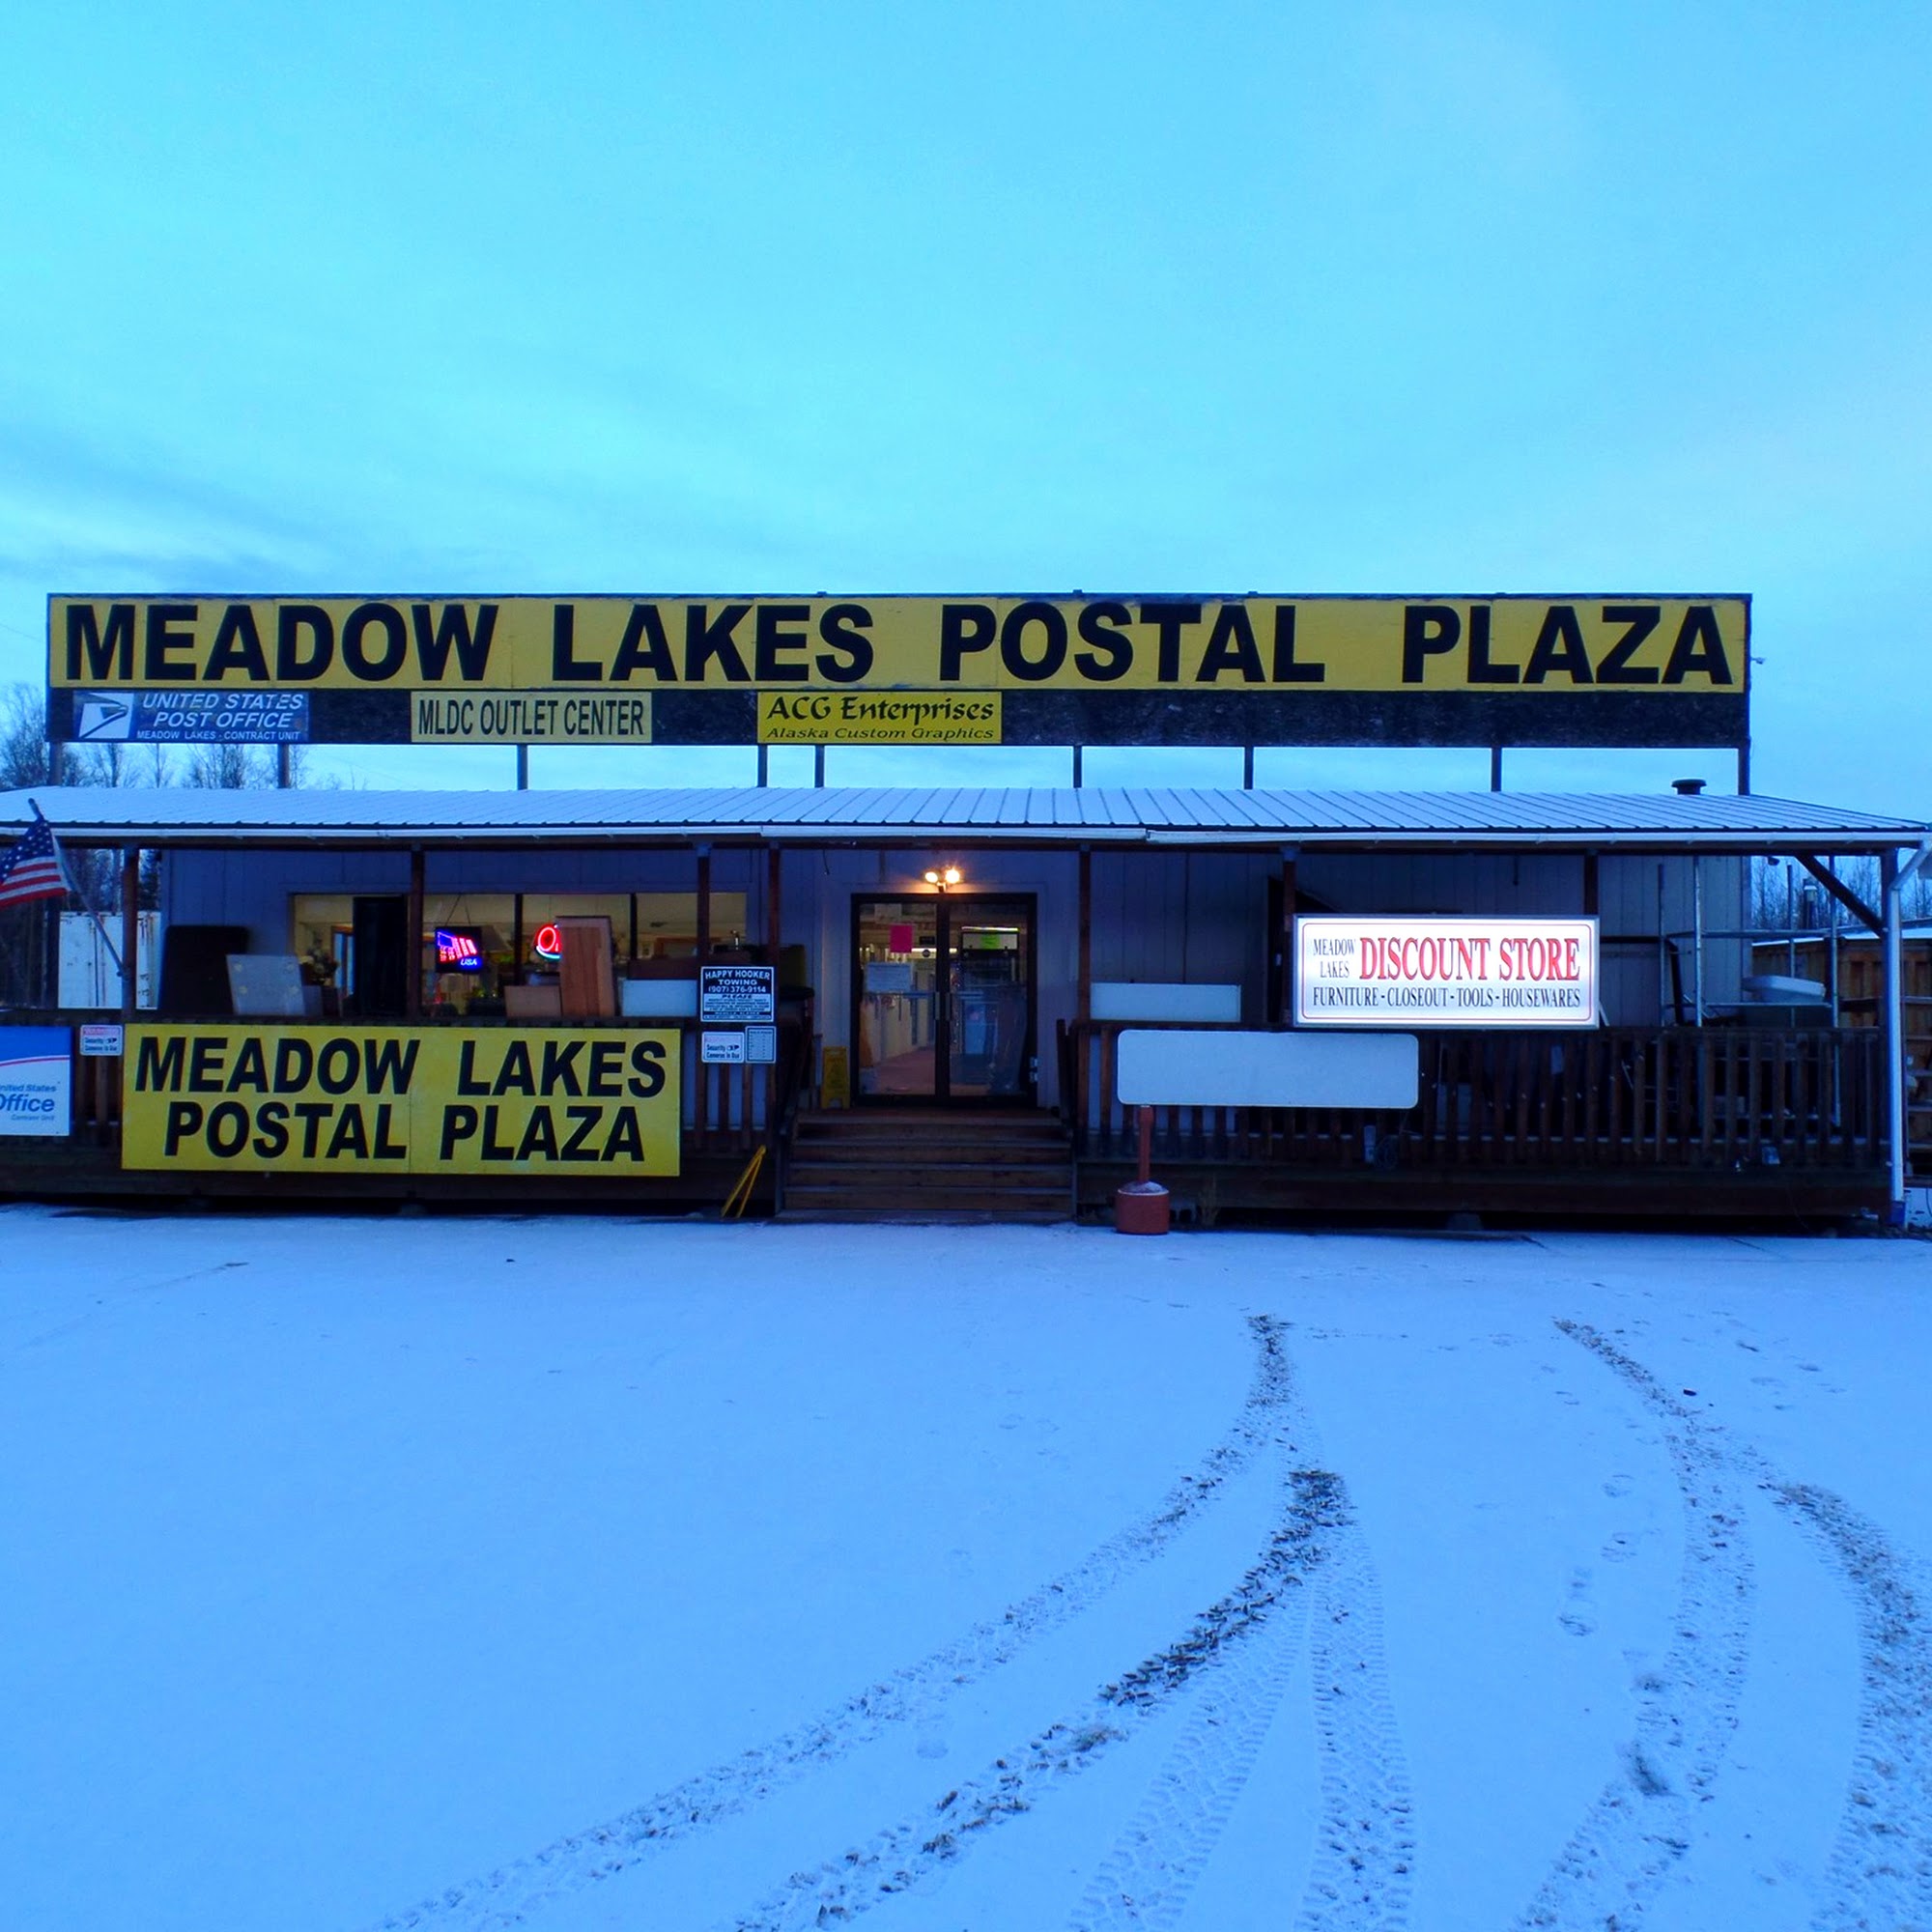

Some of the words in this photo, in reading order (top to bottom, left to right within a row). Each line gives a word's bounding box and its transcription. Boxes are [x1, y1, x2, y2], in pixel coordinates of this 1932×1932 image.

[66, 603, 498, 681] MEADOW
[551, 603, 874, 683] LAKES
[939, 602, 1325, 683] POSTAL
[1402, 605, 1733, 685] PLAZA
[143, 693, 219, 709] UNITED
[225, 693, 304, 710] STATES
[766, 696, 832, 721] ACG
[840, 696, 995, 725] Enterprises
[154, 712, 213, 727] POST
[215, 712, 294, 728] OFFICE
[418, 699, 473, 735] MLDC
[480, 699, 558, 735] OUTLET
[564, 699, 644, 735] CENTER
[136, 730, 180, 740] MEADOW
[185, 730, 216, 740] LAKES
[224, 730, 276, 741] CONTRACT
[278, 730, 301, 741] UNIT
[766, 727, 830, 739] Alaska
[835, 727, 906, 739] Custom
[911, 727, 995, 742] Graphics
[1312, 938, 1356, 956] MEADOW
[1359, 937, 1492, 980] DISCOUNT
[1499, 937, 1580, 981] STORE
[705, 970, 734, 980] HAPPY
[735, 970, 771, 980] HOOKER
[1320, 960, 1350, 979] LAKES
[1313, 986, 1379, 1007] FURNITURE
[1387, 987, 1448, 1008] CLOSEOUT
[1457, 987, 1493, 1008] TOOLS
[1502, 988, 1581, 1008] HOUSEWARES
[135, 1037, 420, 1094] MEADOW
[457, 1040, 667, 1097] LAKES
[0, 1084, 24, 1093] nited
[25, 1084, 57, 1093] States
[164, 1101, 407, 1158] POSTAL
[440, 1104, 645, 1161] PLAZA
